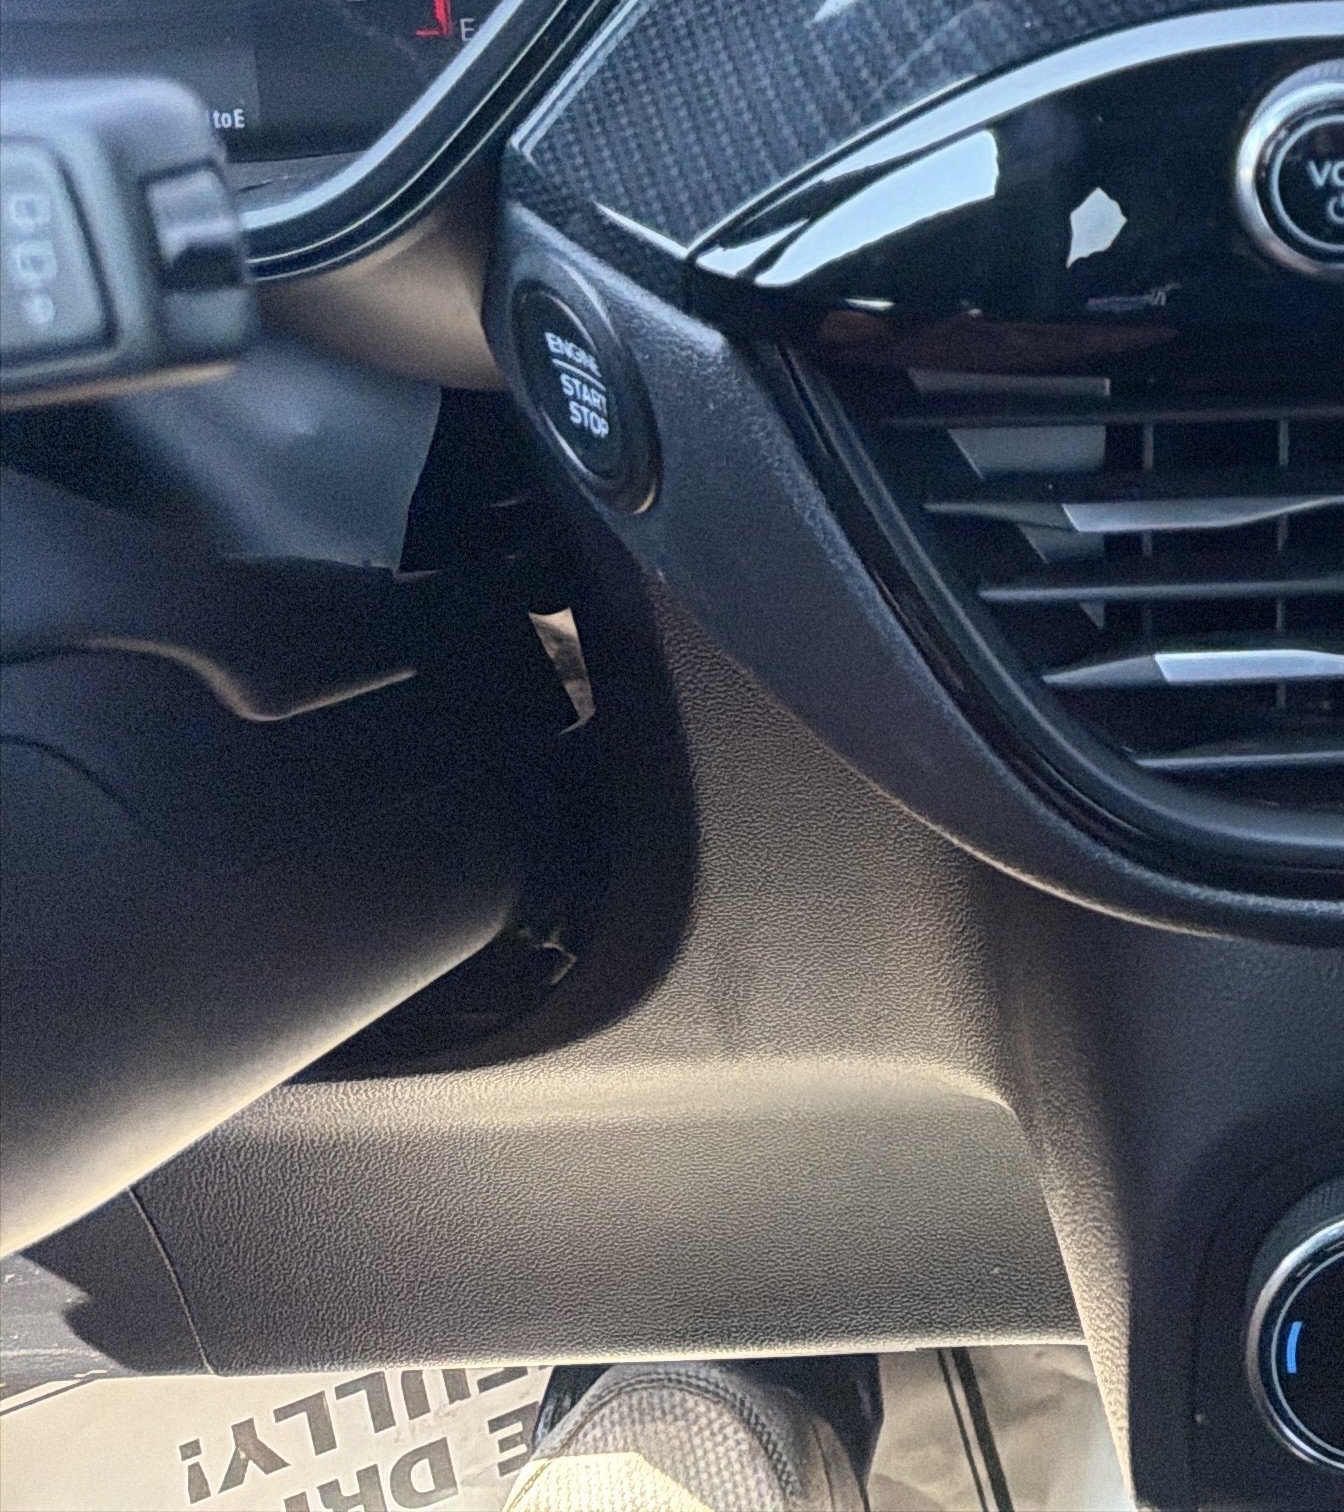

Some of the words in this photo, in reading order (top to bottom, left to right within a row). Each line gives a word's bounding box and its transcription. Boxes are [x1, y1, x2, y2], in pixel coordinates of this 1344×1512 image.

[460, 18, 475, 42] E
[544, 331, 602, 378] ENGINE
[560, 373, 608, 417] START
[568, 400, 610, 439] STOP
